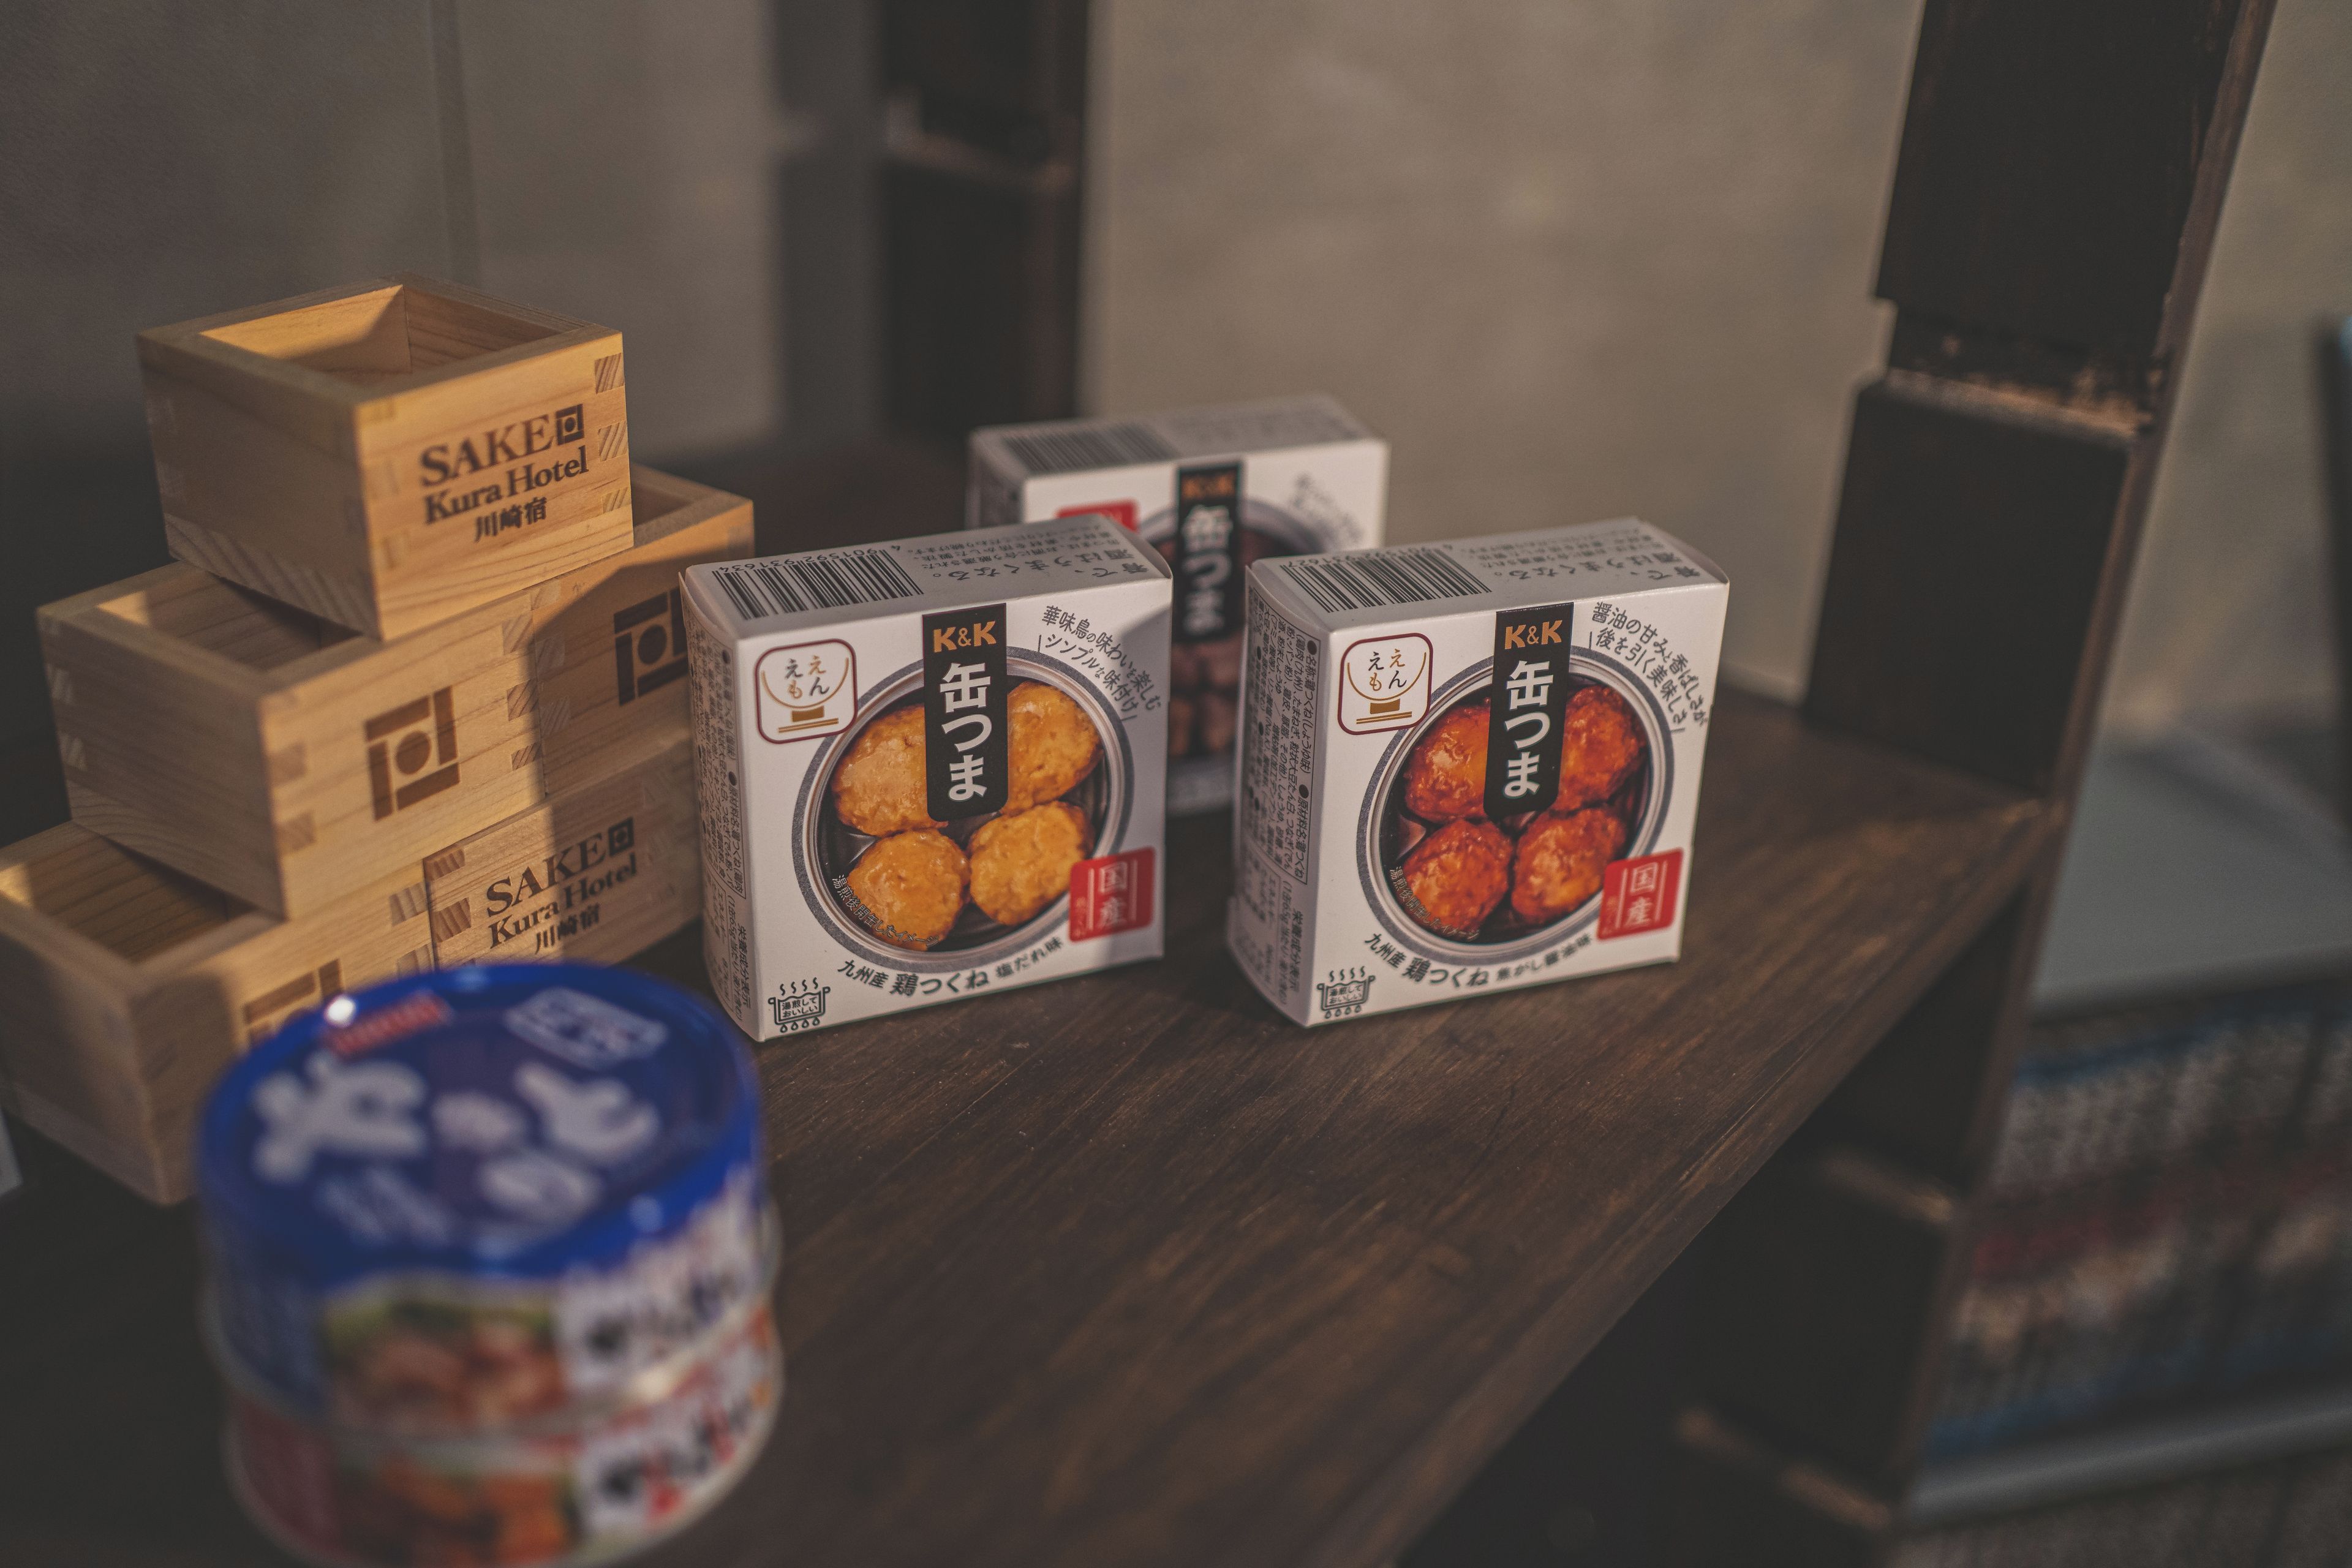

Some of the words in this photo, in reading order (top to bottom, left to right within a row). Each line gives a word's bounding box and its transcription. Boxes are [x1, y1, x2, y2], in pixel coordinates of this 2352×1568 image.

[419, 414, 554, 488] SAKE
[423, 479, 503, 525] Kura
[507, 446, 589, 496] Hotel
[475, 497, 548, 543] 川崎宿
[803, 548, 878, 563] 901592
[718, 558, 795, 573] 931634
[933, 548, 1135, 581] 酒はうまくなる。
[933, 621, 997, 653] K&K
[1042, 605, 1161, 710] 華味鳥の味わいを楽しむ
[1505, 619, 1562, 649] K&K
[1592, 601, 1708, 726] 醤油の甘みと香ばしさが
[1045, 633, 1139, 712] シンプルな味付け
[1596, 627, 1687, 725] 後を引く美味しさ
[940, 662, 992, 801] 缶つま
[1503, 660, 1554, 798] 缶つま
[486, 832, 606, 918] SAKE
[488, 901, 560, 949] Kura
[564, 851, 637, 910] Hotel
[831, 873, 940, 947] 湯煎後開缶したイメージ
[1098, 861, 1129, 929] 国産
[1624, 861, 1659, 928] 国産
[737, 922, 751, 1009] 栄養成分表示
[837, 959, 889, 989] 九州産
[889, 970, 990, 997] 鶏つくね
[995, 936, 1065, 978] 塩だれ味
[1364, 932, 1408, 969] 九州産
[1401, 956, 1491, 989] 鶏つくね
[782, 995, 818, 1011] 湯煎して
[782, 1004, 819, 1018] おいしい
